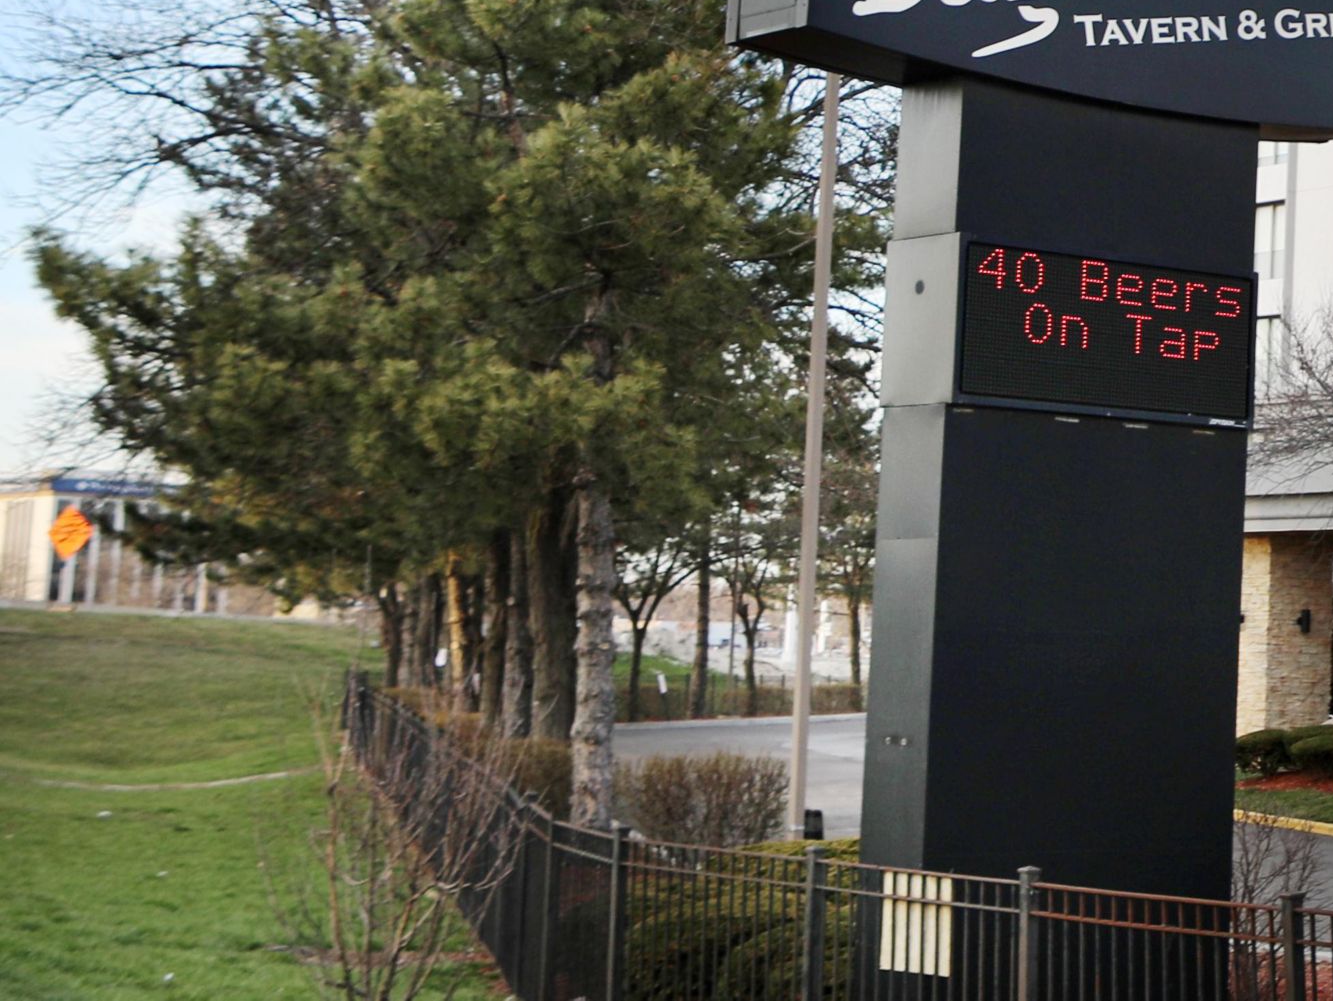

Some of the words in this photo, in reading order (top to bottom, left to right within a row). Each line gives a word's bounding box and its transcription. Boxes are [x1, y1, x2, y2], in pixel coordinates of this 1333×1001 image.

[1073, 13, 1228, 47] TAVERN
[1237, 9, 1267, 41] &
[977, 248, 1046, 294] 40
[1078, 259, 1243, 318] Beers
[1024, 302, 1089, 350] On
[1125, 312, 1222, 361] Tap
